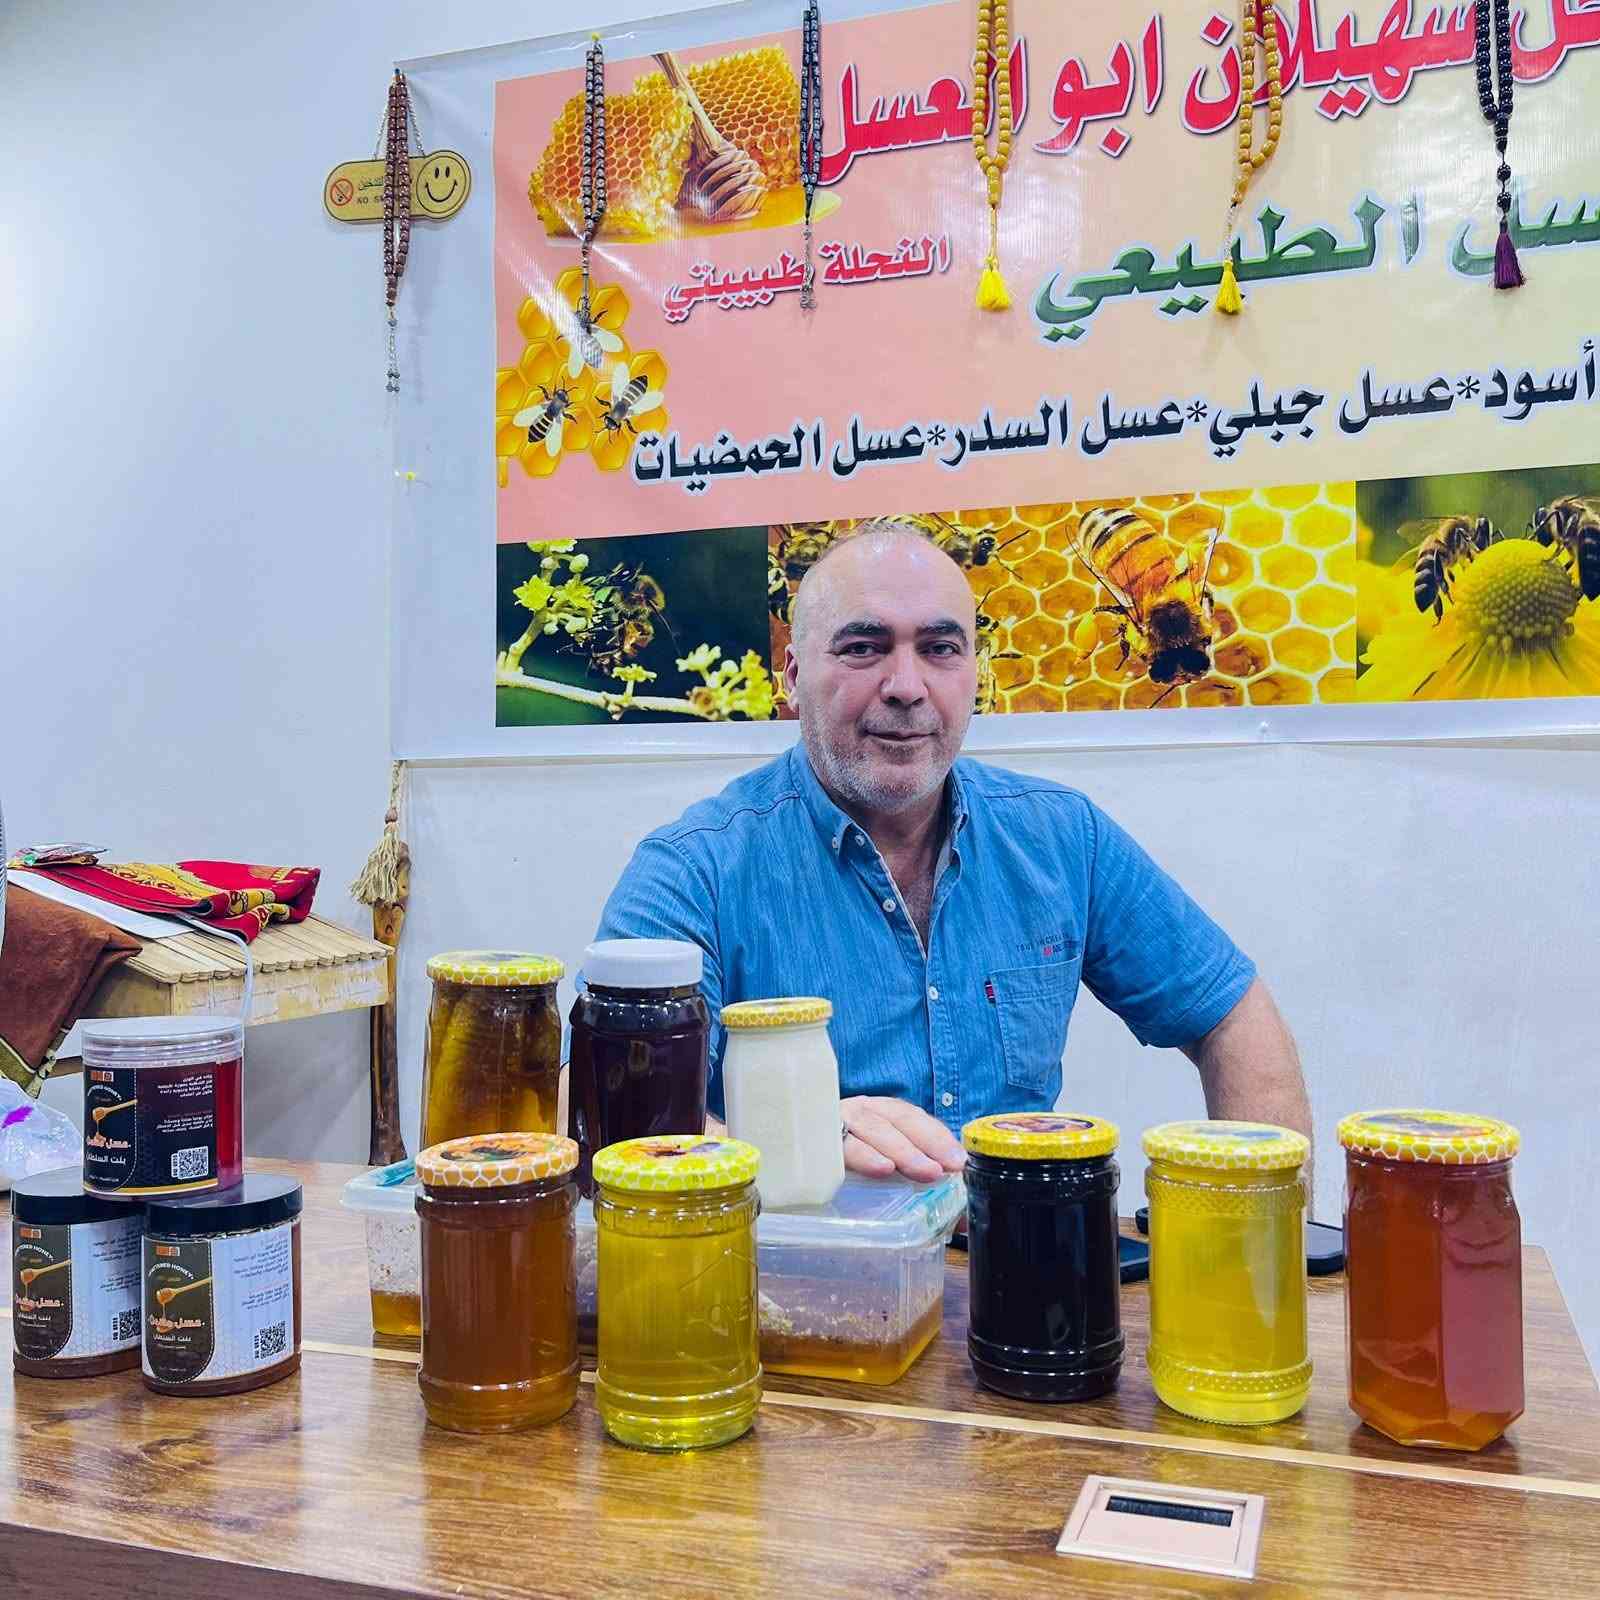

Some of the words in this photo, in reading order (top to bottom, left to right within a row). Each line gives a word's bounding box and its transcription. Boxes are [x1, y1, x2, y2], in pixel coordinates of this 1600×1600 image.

[814, 37, 1026, 184] العسل
[1037, 15, 1161, 155] ابو
[821, 235, 949, 280] النحلة
[1036, 193, 1418, 341] الطبيعي
[1452, 182, 1600, 275] سل
[664, 254, 812, 319] طبيبتي
[633, 424, 821, 491] الحمضيات
